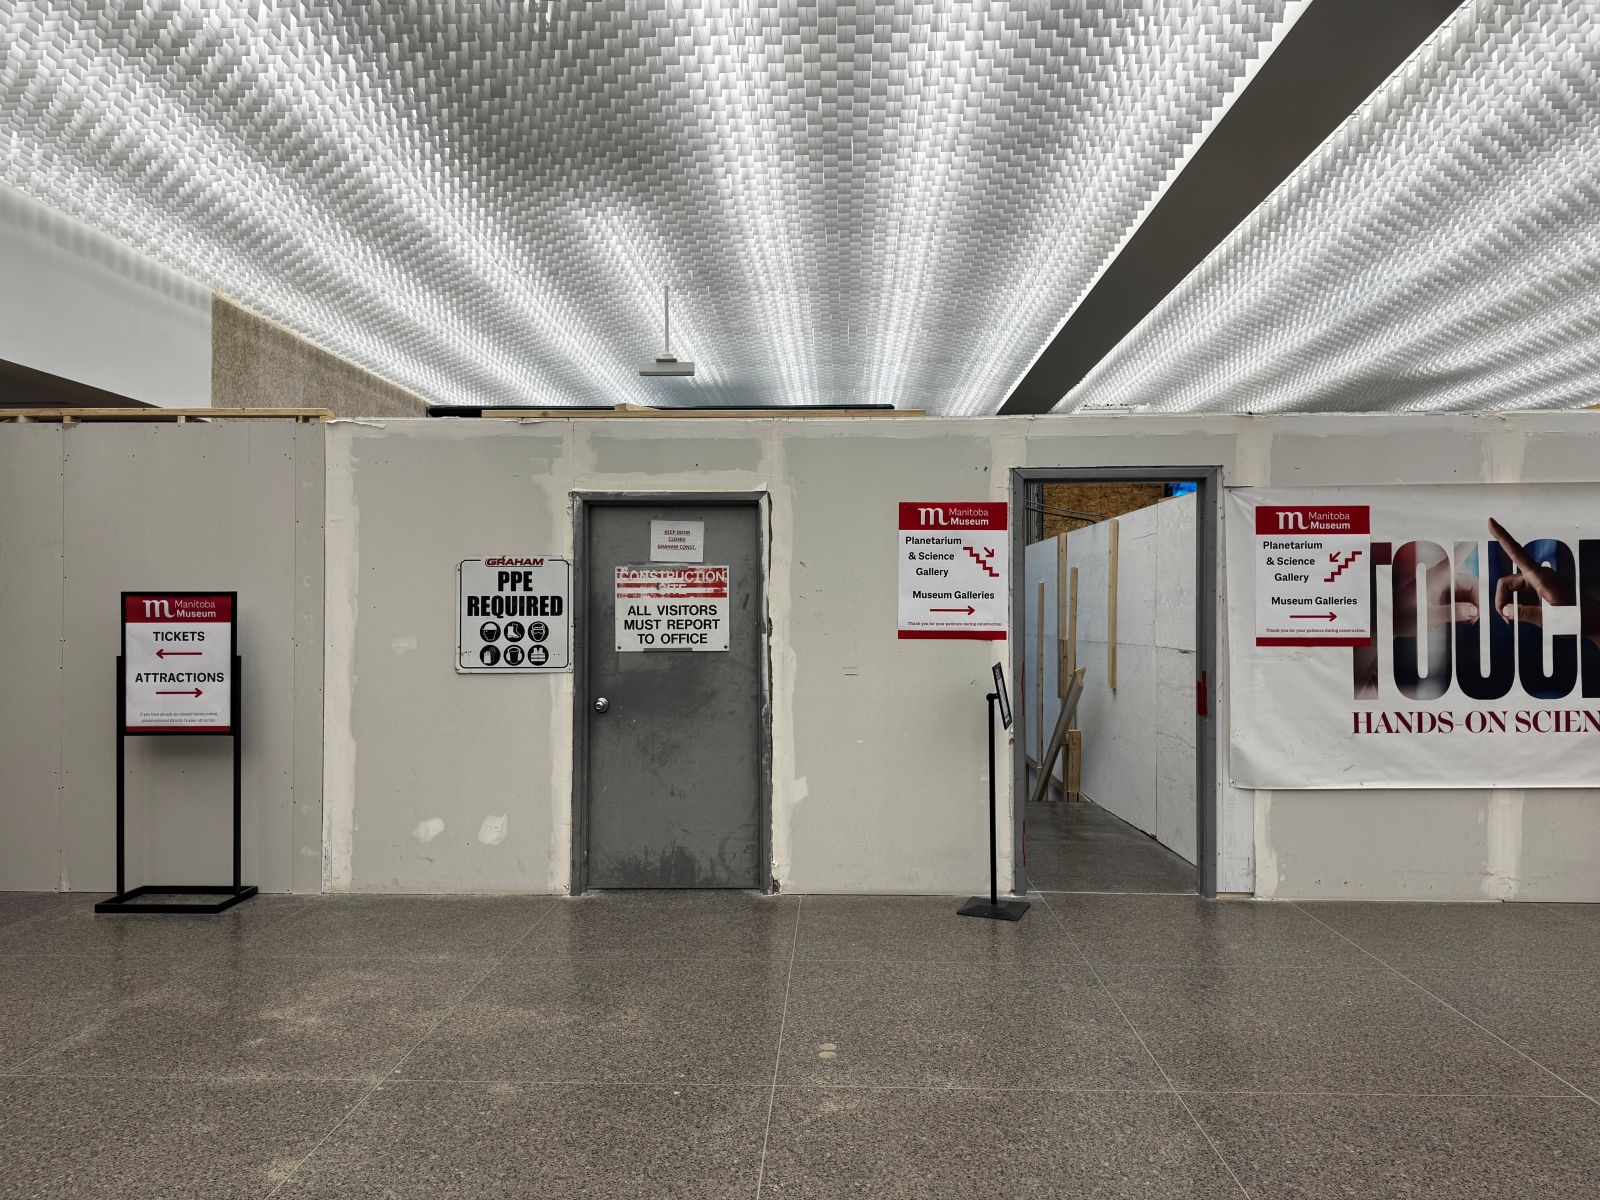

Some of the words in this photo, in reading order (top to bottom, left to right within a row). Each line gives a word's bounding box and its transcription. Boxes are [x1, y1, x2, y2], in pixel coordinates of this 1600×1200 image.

[949, 508, 988, 516] Manitoba
[1308, 512, 1350, 520] Manitoba
[1310, 522, 1350, 530] Museum
[905, 537, 961, 545] Planetarium
[1263, 541, 1322, 550] Planetarium
[909, 552, 916, 560] &
[919, 552, 954, 560] Science
[485, 556, 545, 567] GRAHAM
[1266, 557, 1274, 565] &
[1277, 557, 1315, 566] Science
[916, 567, 948, 577] Gallery
[498, 571, 533, 592] PPE
[1275, 573, 1309, 583] Gallery
[912, 591, 951, 599] Museum
[954, 591, 994, 599] Galleries
[174, 600, 216, 609] Manitoba
[1271, 597, 1312, 605] Museum
[1315, 597, 1357, 606] Galleries
[467, 595, 563, 618] REQUIRED
[628, 605, 651, 616] ALL
[657, 605, 717, 616] VISITORS
[176, 610, 216, 618] Museum
[624, 619, 661, 630] MUST
[667, 619, 720, 630] REPORT
[153, 631, 205, 642] TICKETS
[637, 633, 655, 644] TO
[661, 633, 708, 644] OFFICE
[135, 672, 224, 683] ATTRACTIONS
[1352, 710, 1507, 734] HANDS-ON
